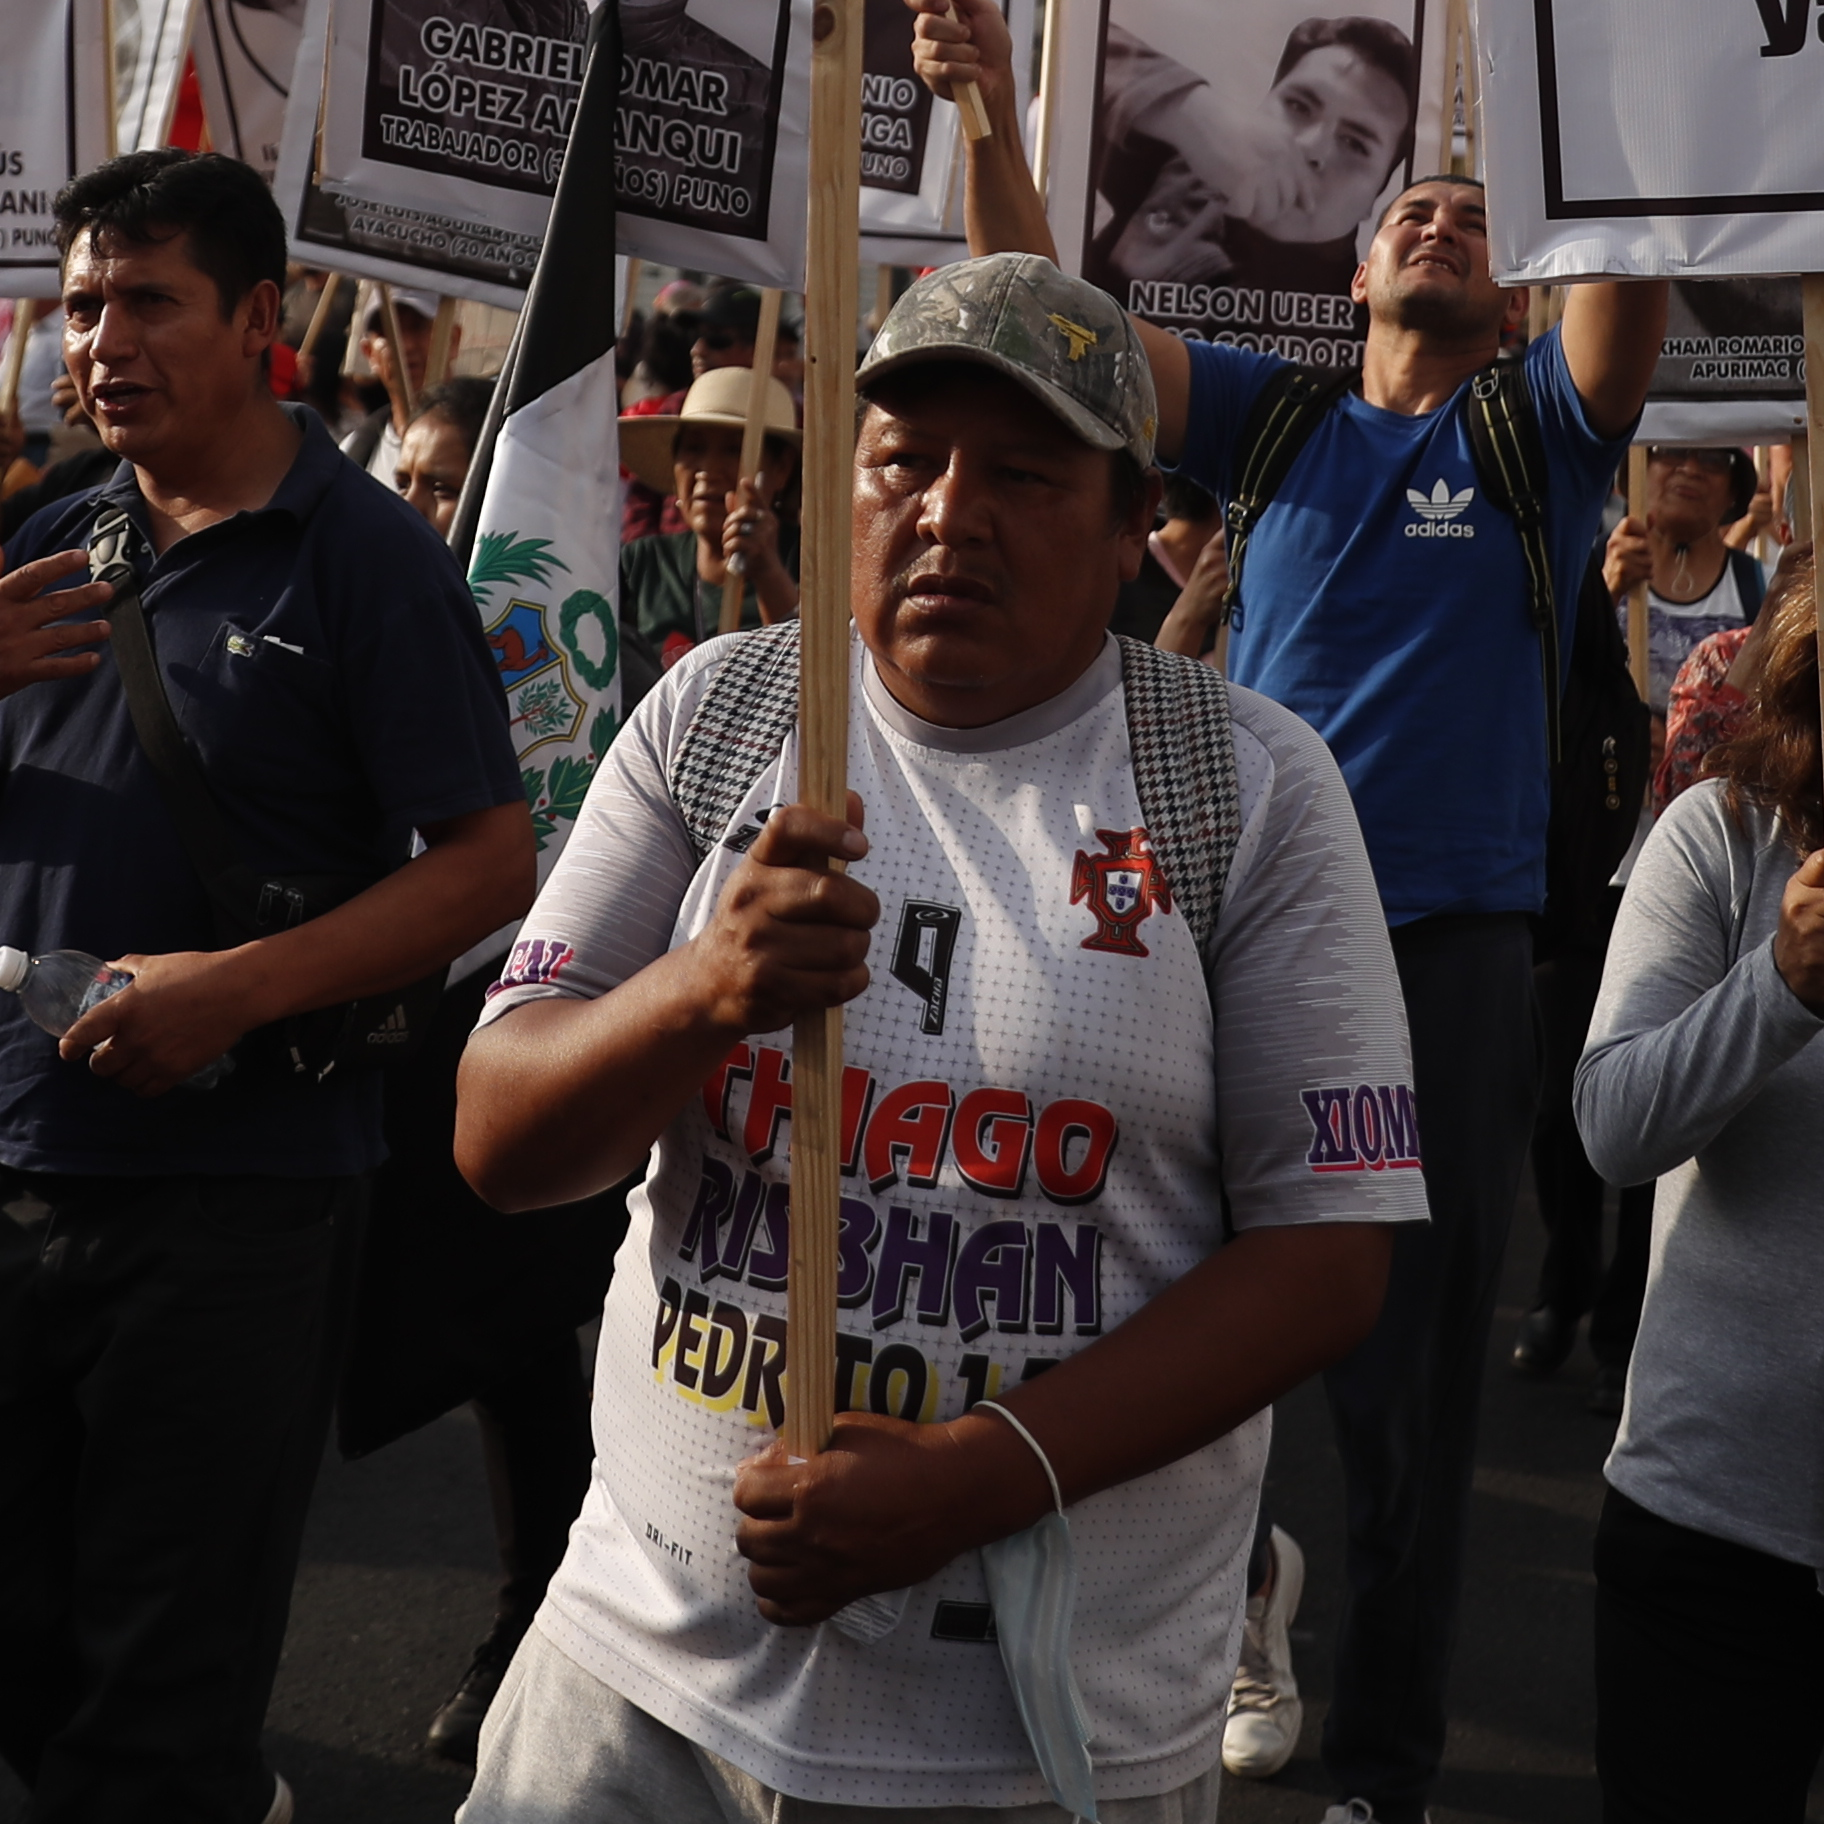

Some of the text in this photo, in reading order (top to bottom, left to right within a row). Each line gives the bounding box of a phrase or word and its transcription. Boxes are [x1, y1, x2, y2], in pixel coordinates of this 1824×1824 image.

[421, 17, 586, 86] GABRIEL
[399, 61, 527, 128] LÓPEZ
[381, 115, 538, 174] TRABAJADOR
[674, 176, 750, 216] PUNO
[350, 215, 447, 250] AYACUCHO
[1129, 280, 1354, 329] NELSON UBER
[1716, 335, 1804, 357] ROMARIO
[1404, 521, 1475, 538] adidas
[645, 1522, 694, 1567] DRI-FIT
